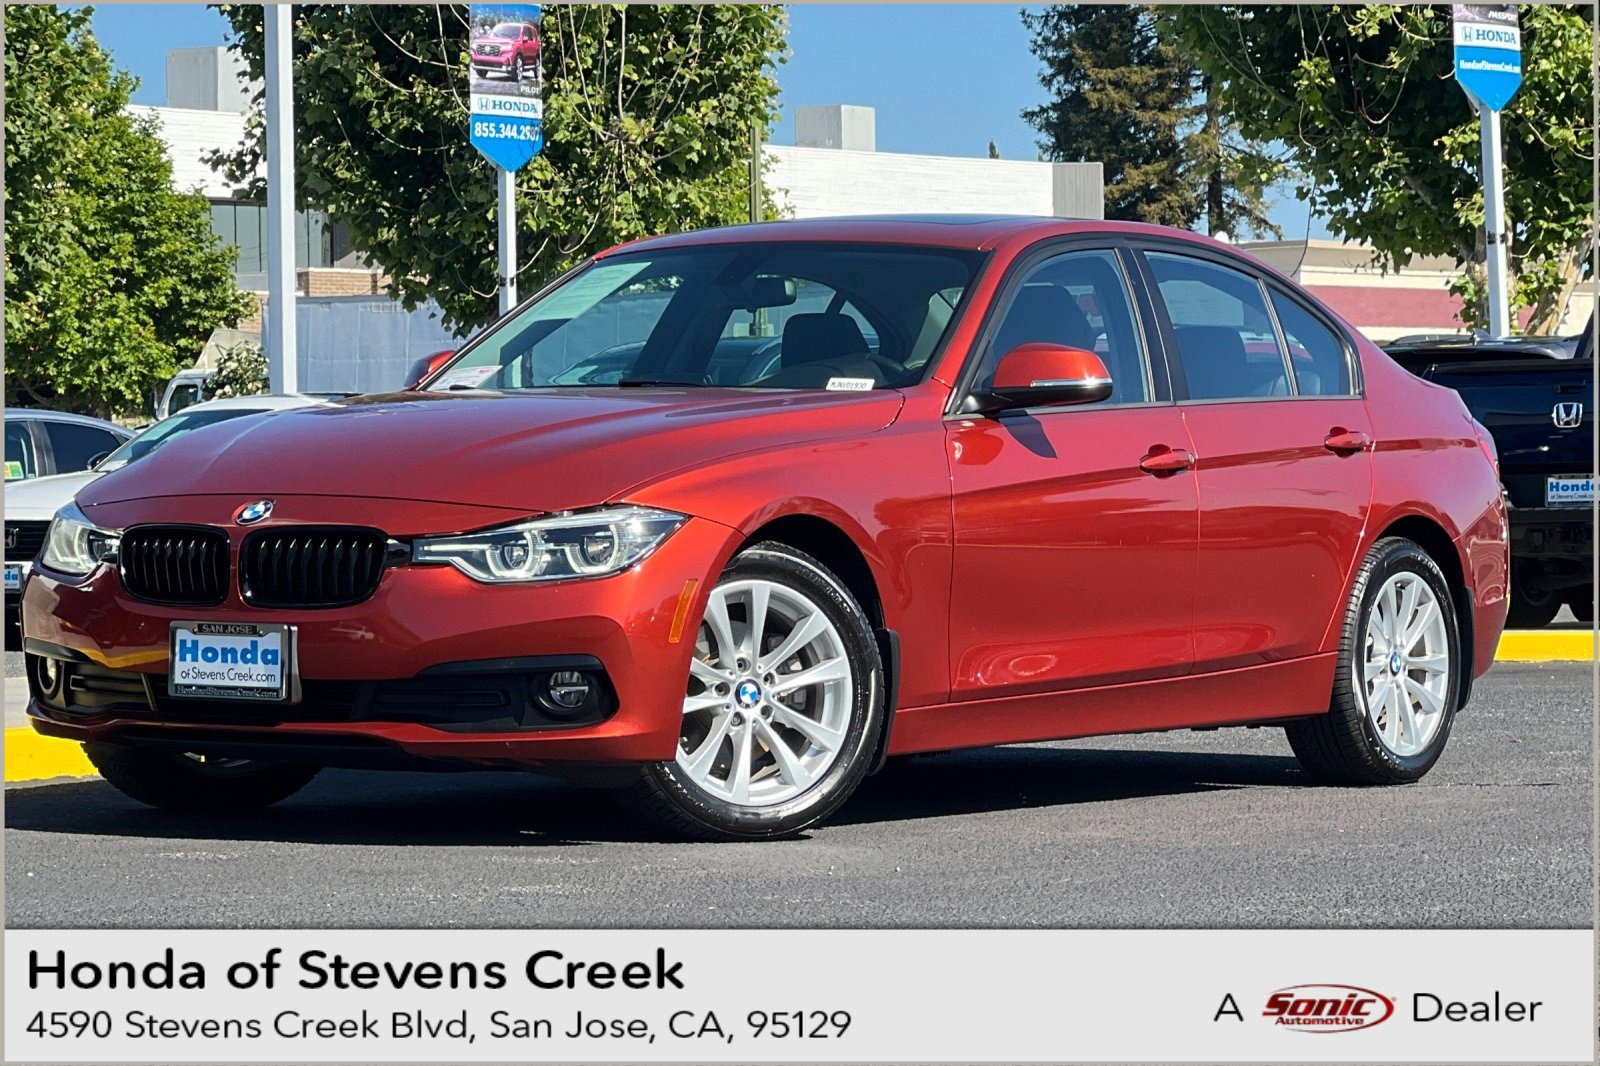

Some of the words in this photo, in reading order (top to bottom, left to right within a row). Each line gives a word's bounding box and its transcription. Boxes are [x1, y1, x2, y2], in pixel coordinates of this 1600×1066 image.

[1476, 30, 1516, 44] HONDA
[521, 86, 539, 94] PILOT
[492, 100, 538, 113] HONDA
[202, 624, 223, 634] SAN
[225, 625, 254, 634] JOSE
[179, 639, 279, 665] Honda
[180, 668, 191, 679] of
[192, 666, 226, 681] Stevens
[227, 667, 276, 683] Creek.com
